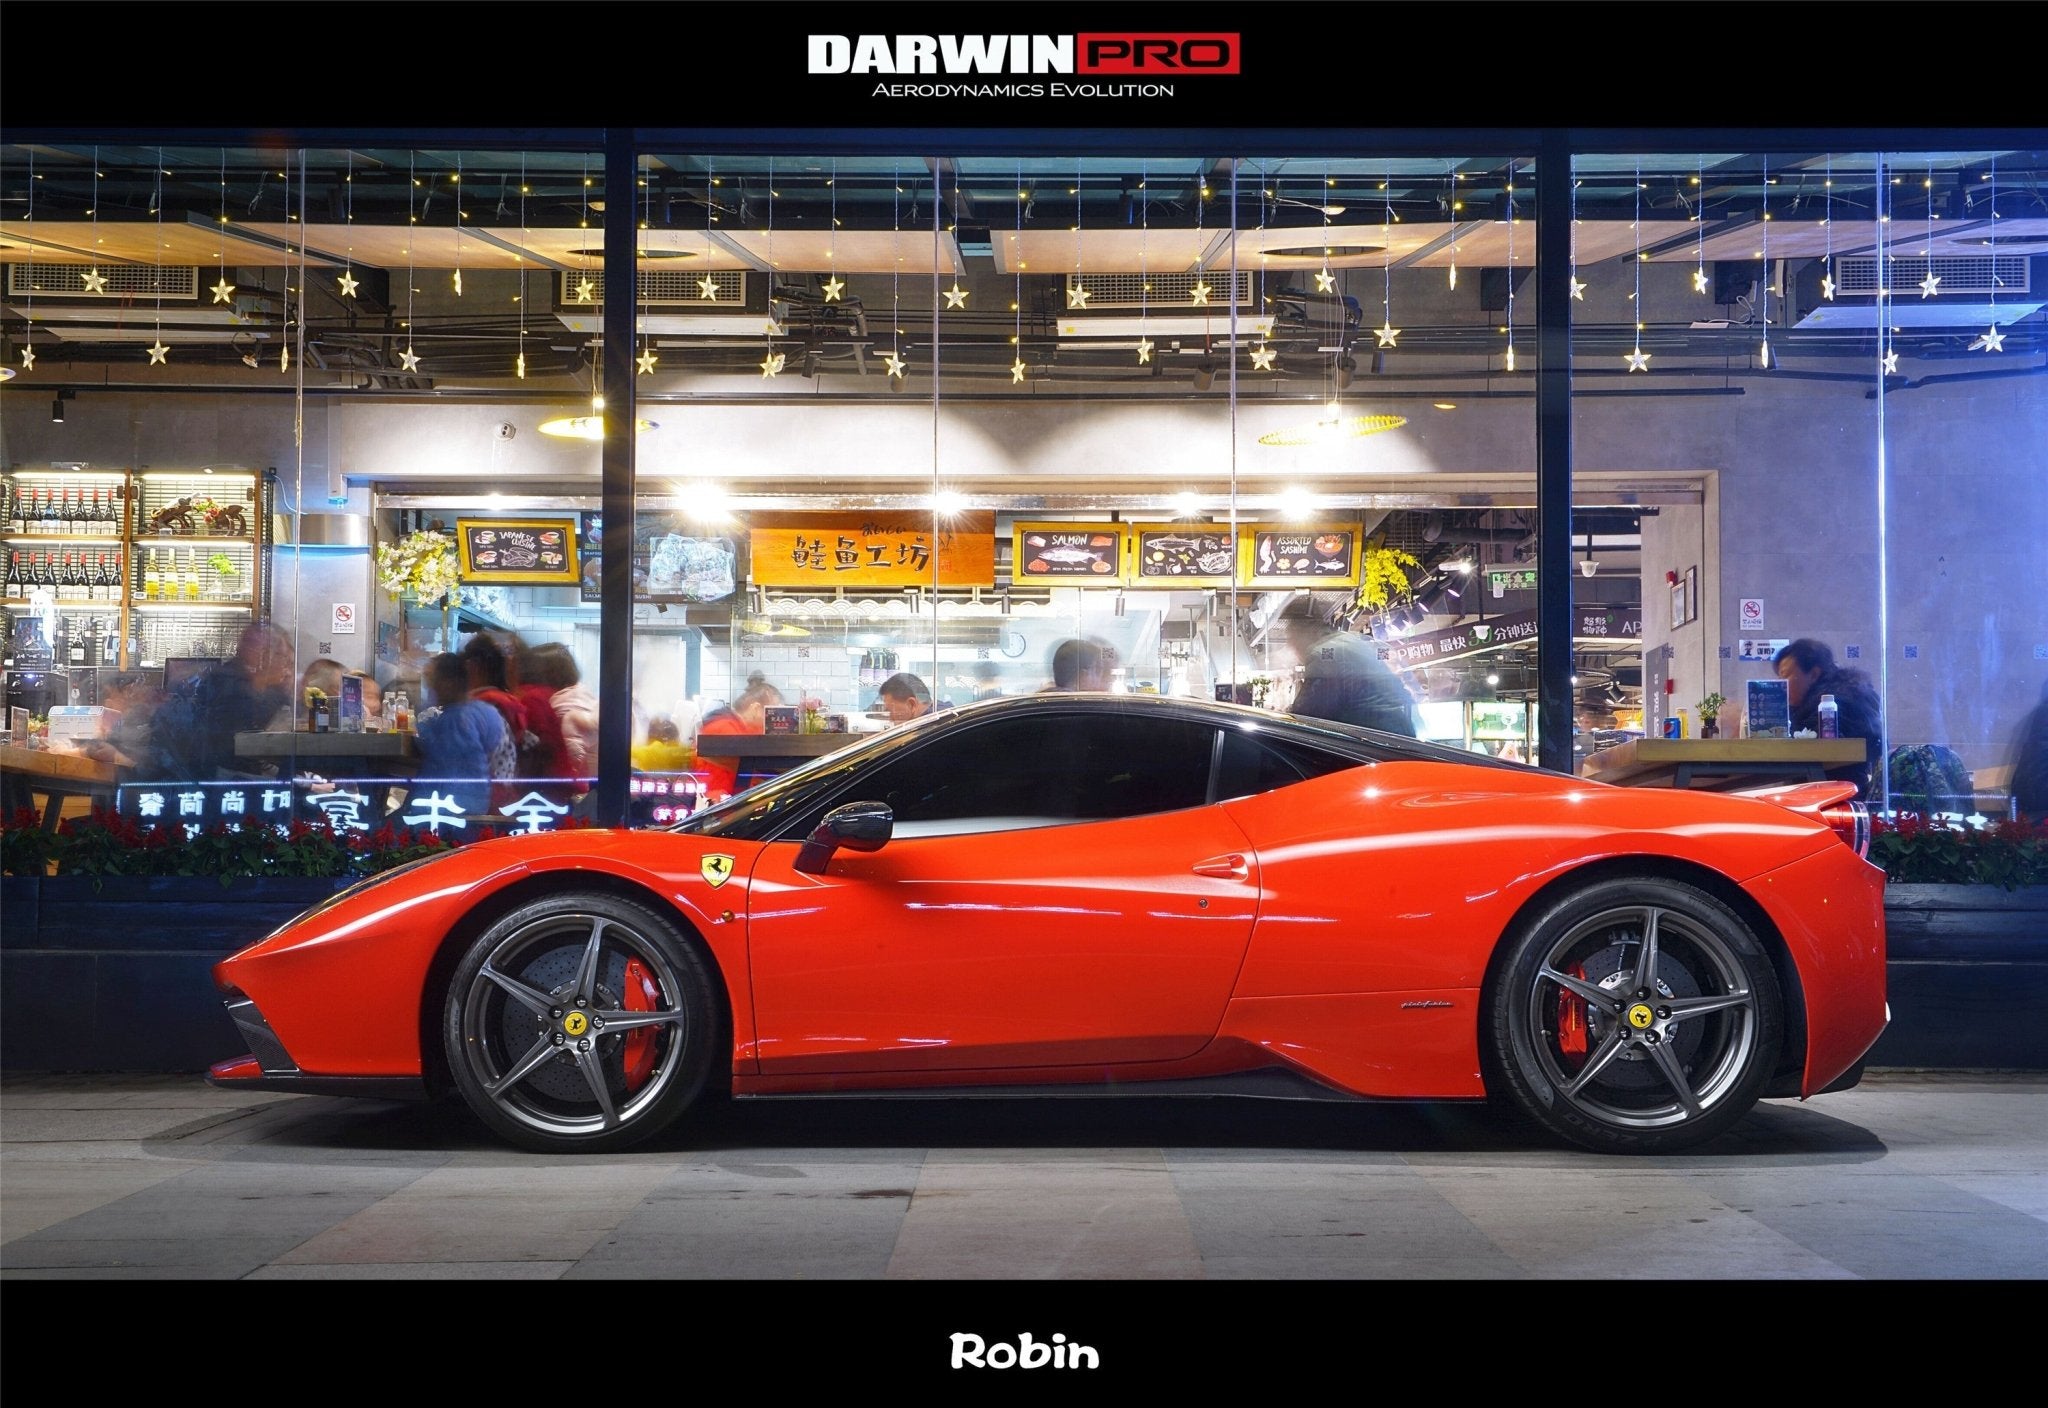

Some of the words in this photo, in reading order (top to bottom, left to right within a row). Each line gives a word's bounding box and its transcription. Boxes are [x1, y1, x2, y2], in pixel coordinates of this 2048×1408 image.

[512, 539, 537, 551] CUISINE
[1051, 533, 1088, 546] SALMON
[1277, 536, 1312, 547] ASSORTED
[793, 535, 929, 571] 鲑鱼工坊
[1280, 545, 1308, 555] SASHIMI
